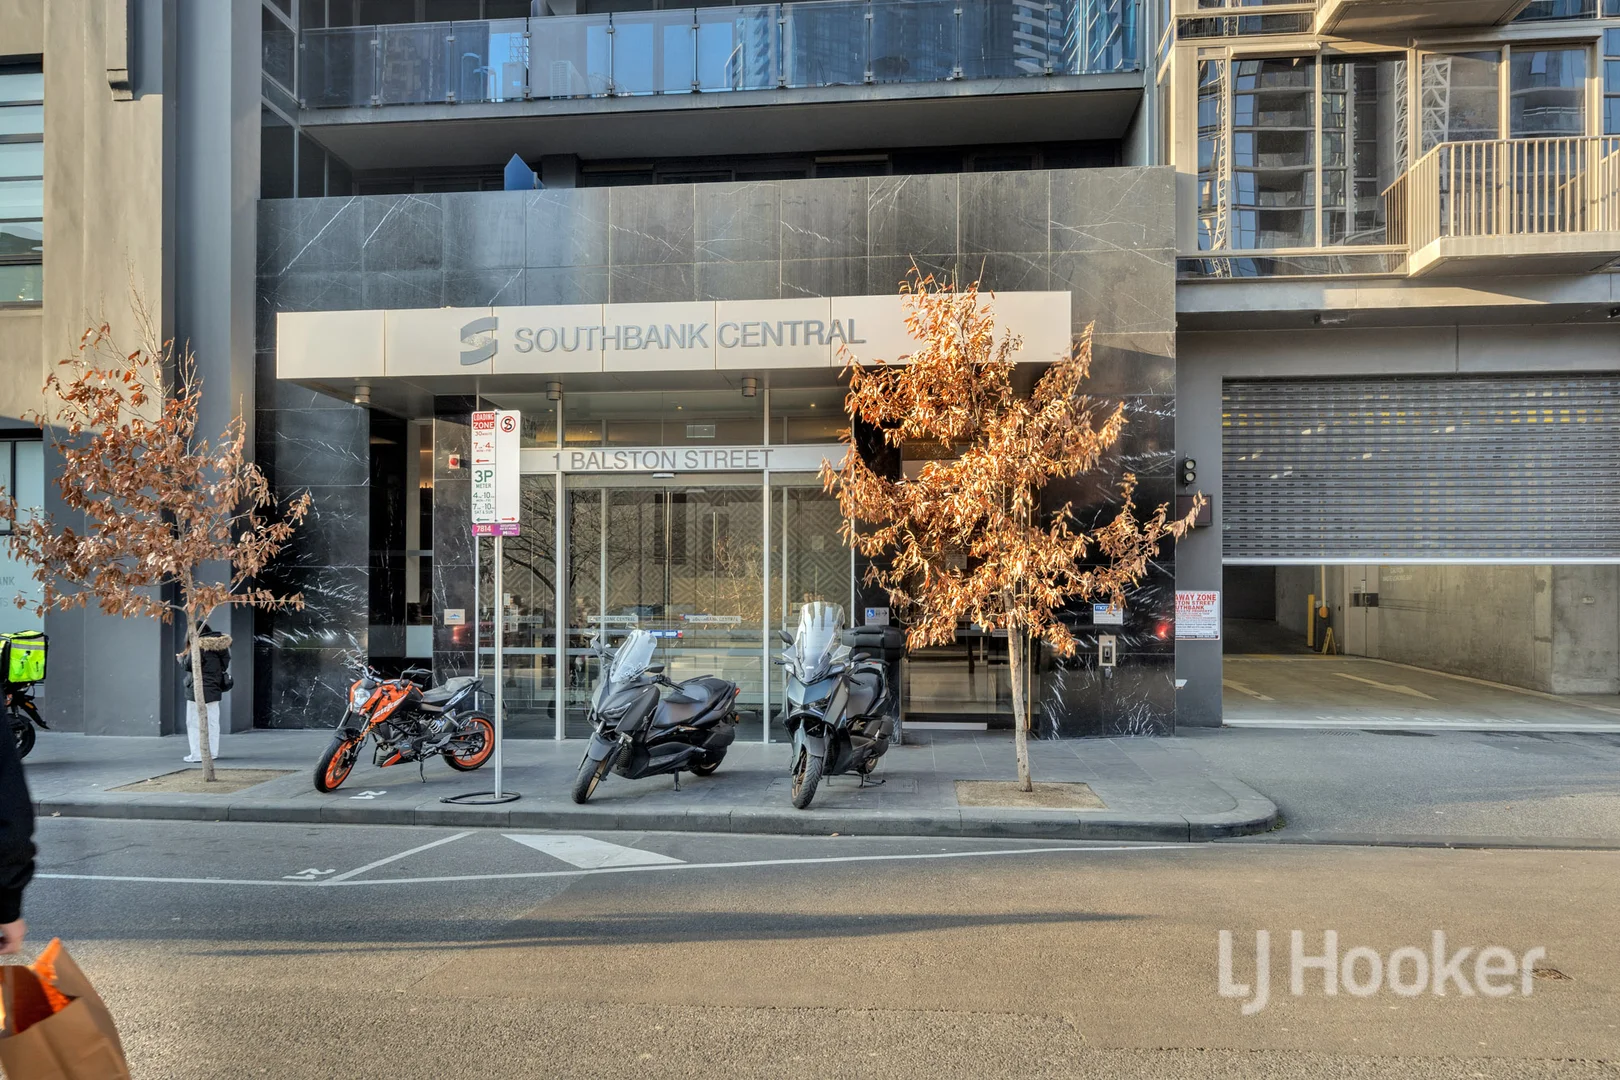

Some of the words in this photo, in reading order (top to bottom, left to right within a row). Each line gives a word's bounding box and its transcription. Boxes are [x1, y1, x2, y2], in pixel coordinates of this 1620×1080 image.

[514, 322, 708, 354] SOUTHBANK
[716, 318, 866, 348] CENTRAL
[474, 413, 494, 421] LOADING
[474, 421, 494, 429] ZONE
[552, 452, 561, 473] 1
[570, 450, 679, 473] BALSTON
[684, 449, 774, 472] STREET
[474, 470, 493, 483] 3P
[476, 525, 492, 533] 7814
